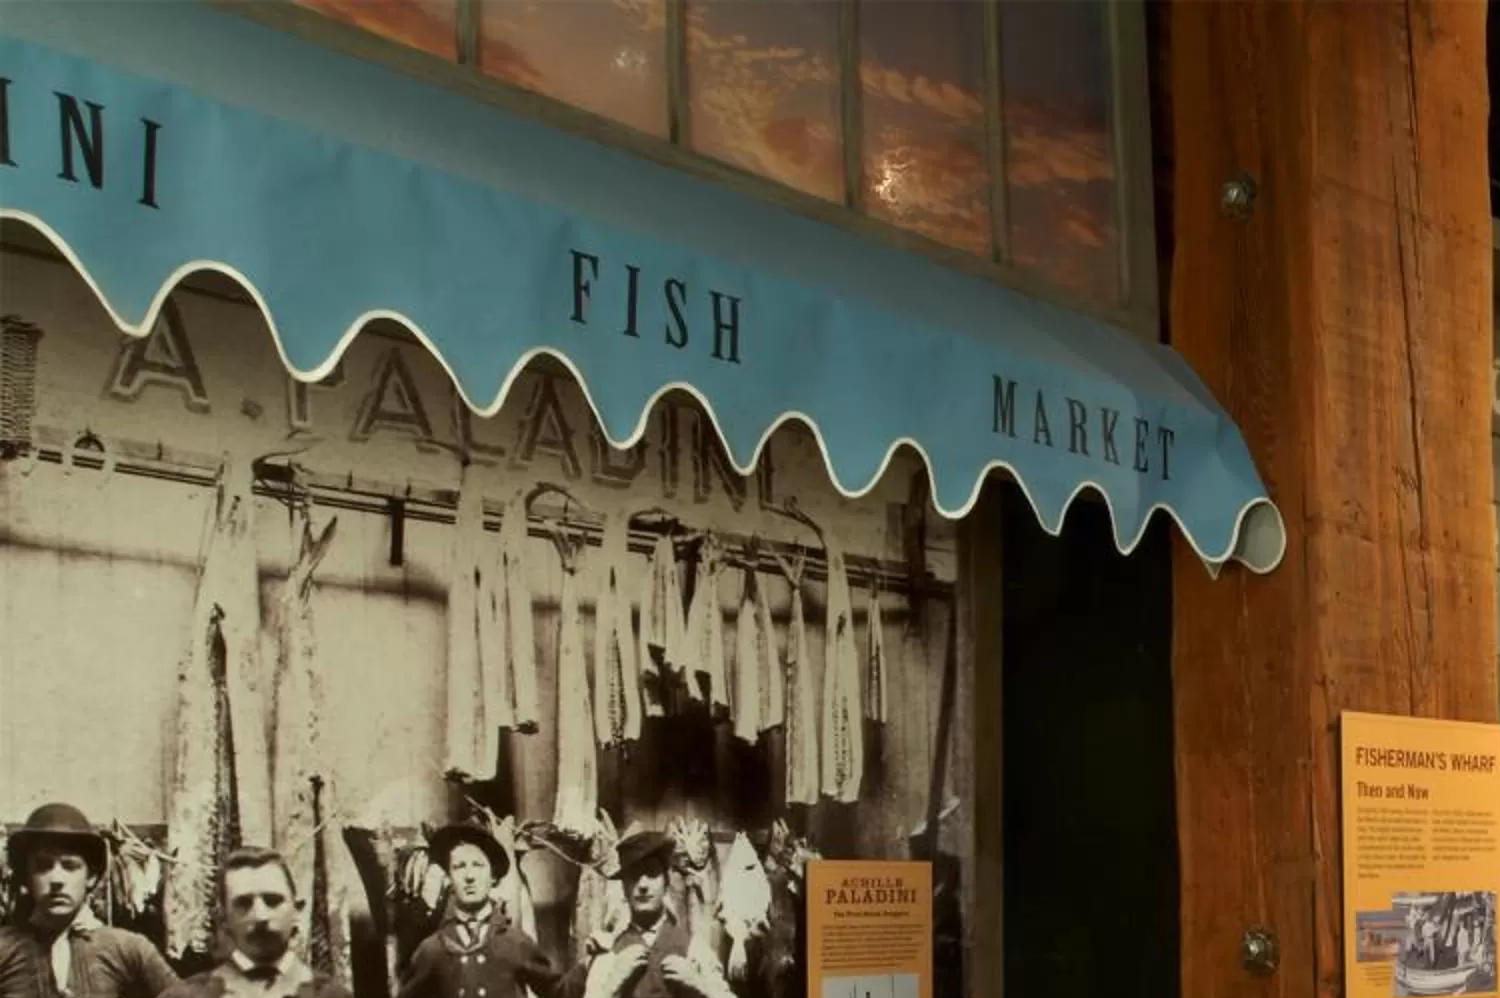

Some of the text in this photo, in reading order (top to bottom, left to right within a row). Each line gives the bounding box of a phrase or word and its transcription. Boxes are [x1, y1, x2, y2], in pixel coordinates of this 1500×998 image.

[568, 248, 743, 364] FISH
[992, 373, 1175, 481] MARKET
[1355, 746, 1497, 774] FISHERMAN'S WHARF
[1356, 781, 1430, 801] Then and Now
[841, 877, 904, 889] ACHILLE
[824, 887, 917, 905] PALADINI
